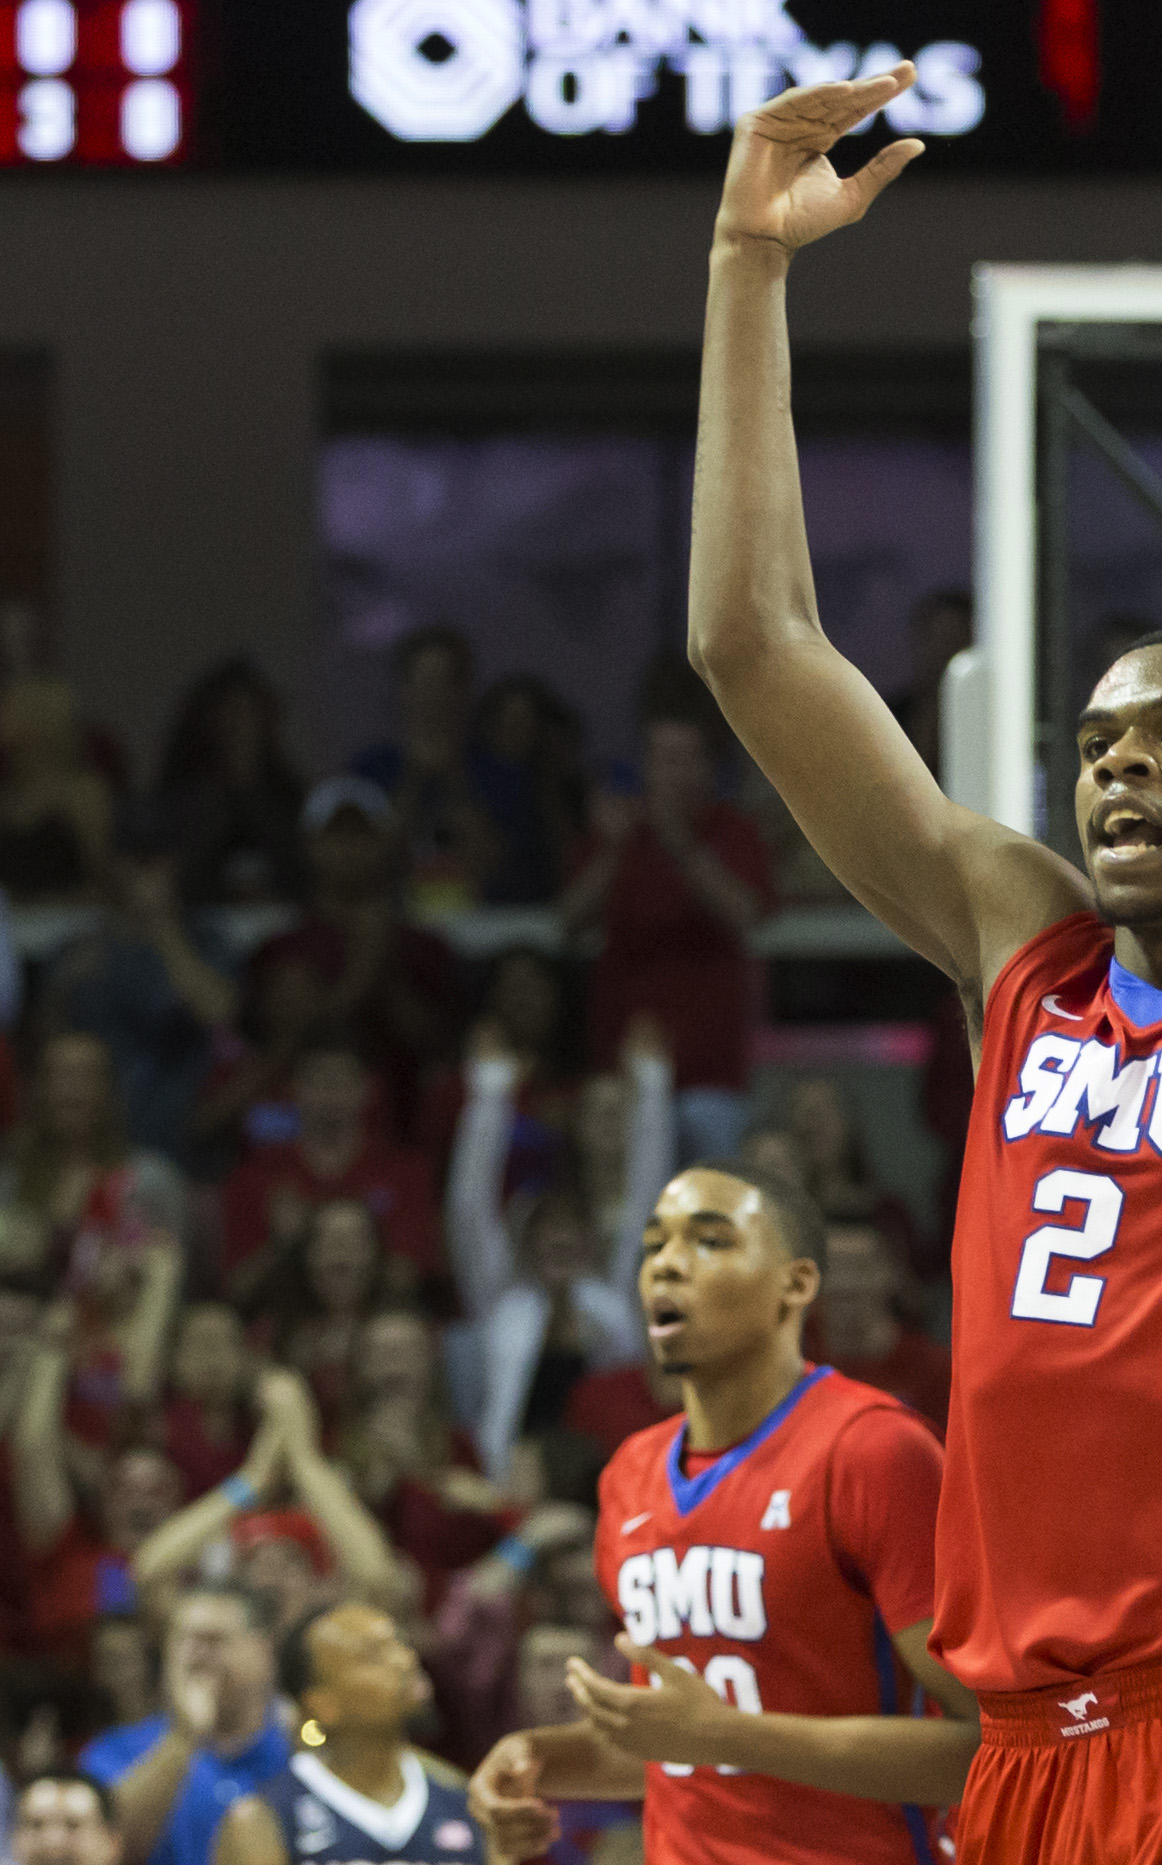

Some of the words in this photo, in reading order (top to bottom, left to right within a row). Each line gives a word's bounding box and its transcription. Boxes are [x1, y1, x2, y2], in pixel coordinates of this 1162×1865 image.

[1009, 1166, 1126, 1328] 2
[616, 1543, 769, 1648] SMU
[1060, 1716, 1111, 1738] MUSTANGS
